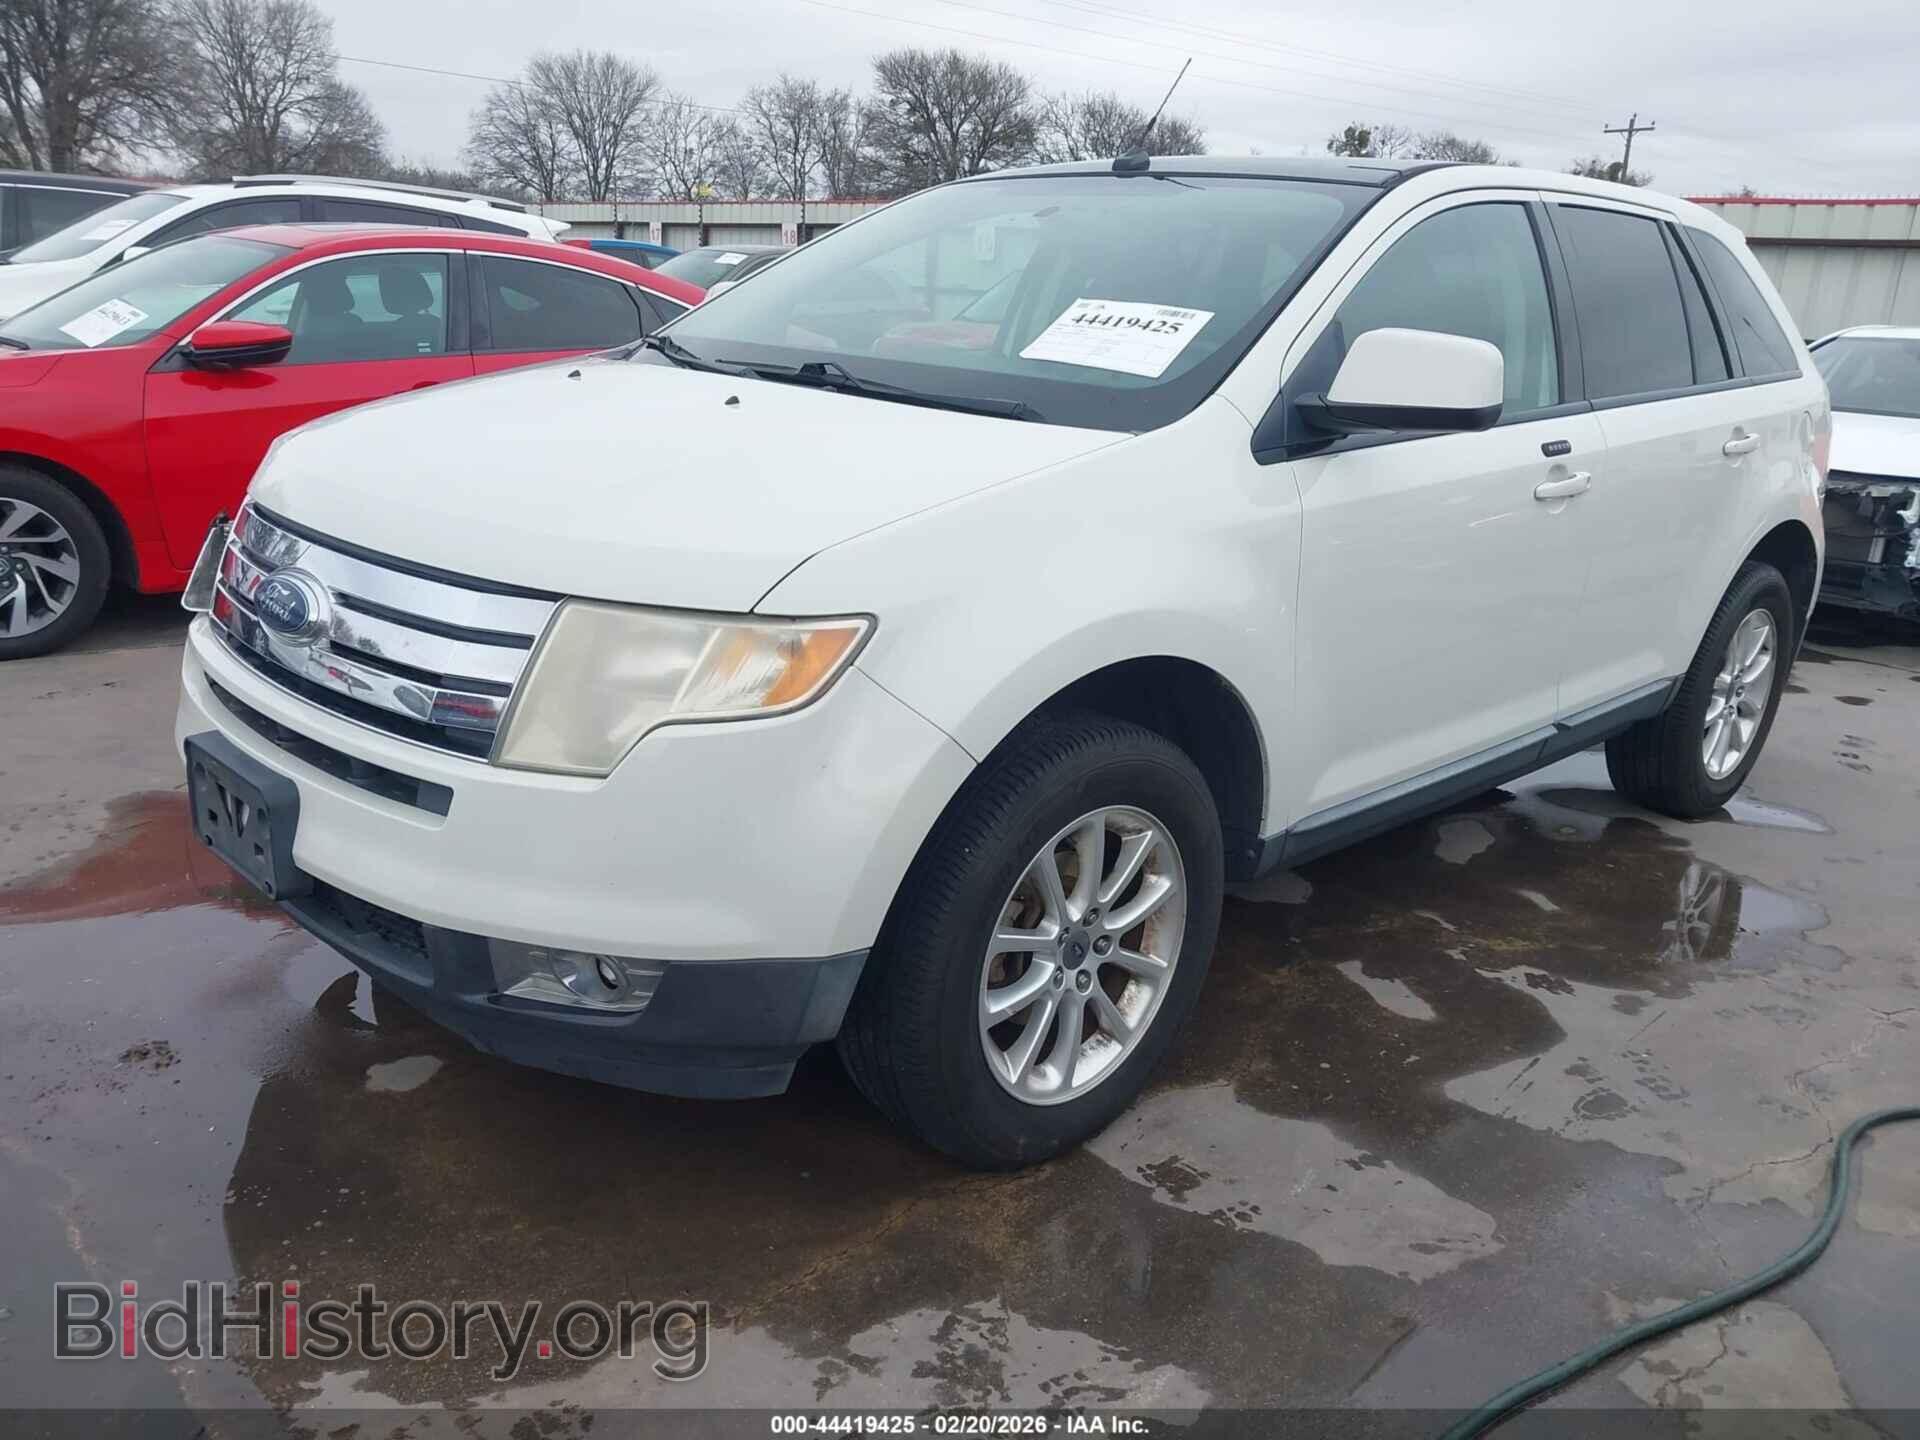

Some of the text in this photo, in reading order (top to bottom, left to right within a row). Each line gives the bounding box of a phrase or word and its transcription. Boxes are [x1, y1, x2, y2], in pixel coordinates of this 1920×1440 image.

[650, 227, 661, 242] 17
[782, 229, 797, 245] 18
[1071, 313, 1185, 335] 44419425
[261, 582, 297, 621] Ford
